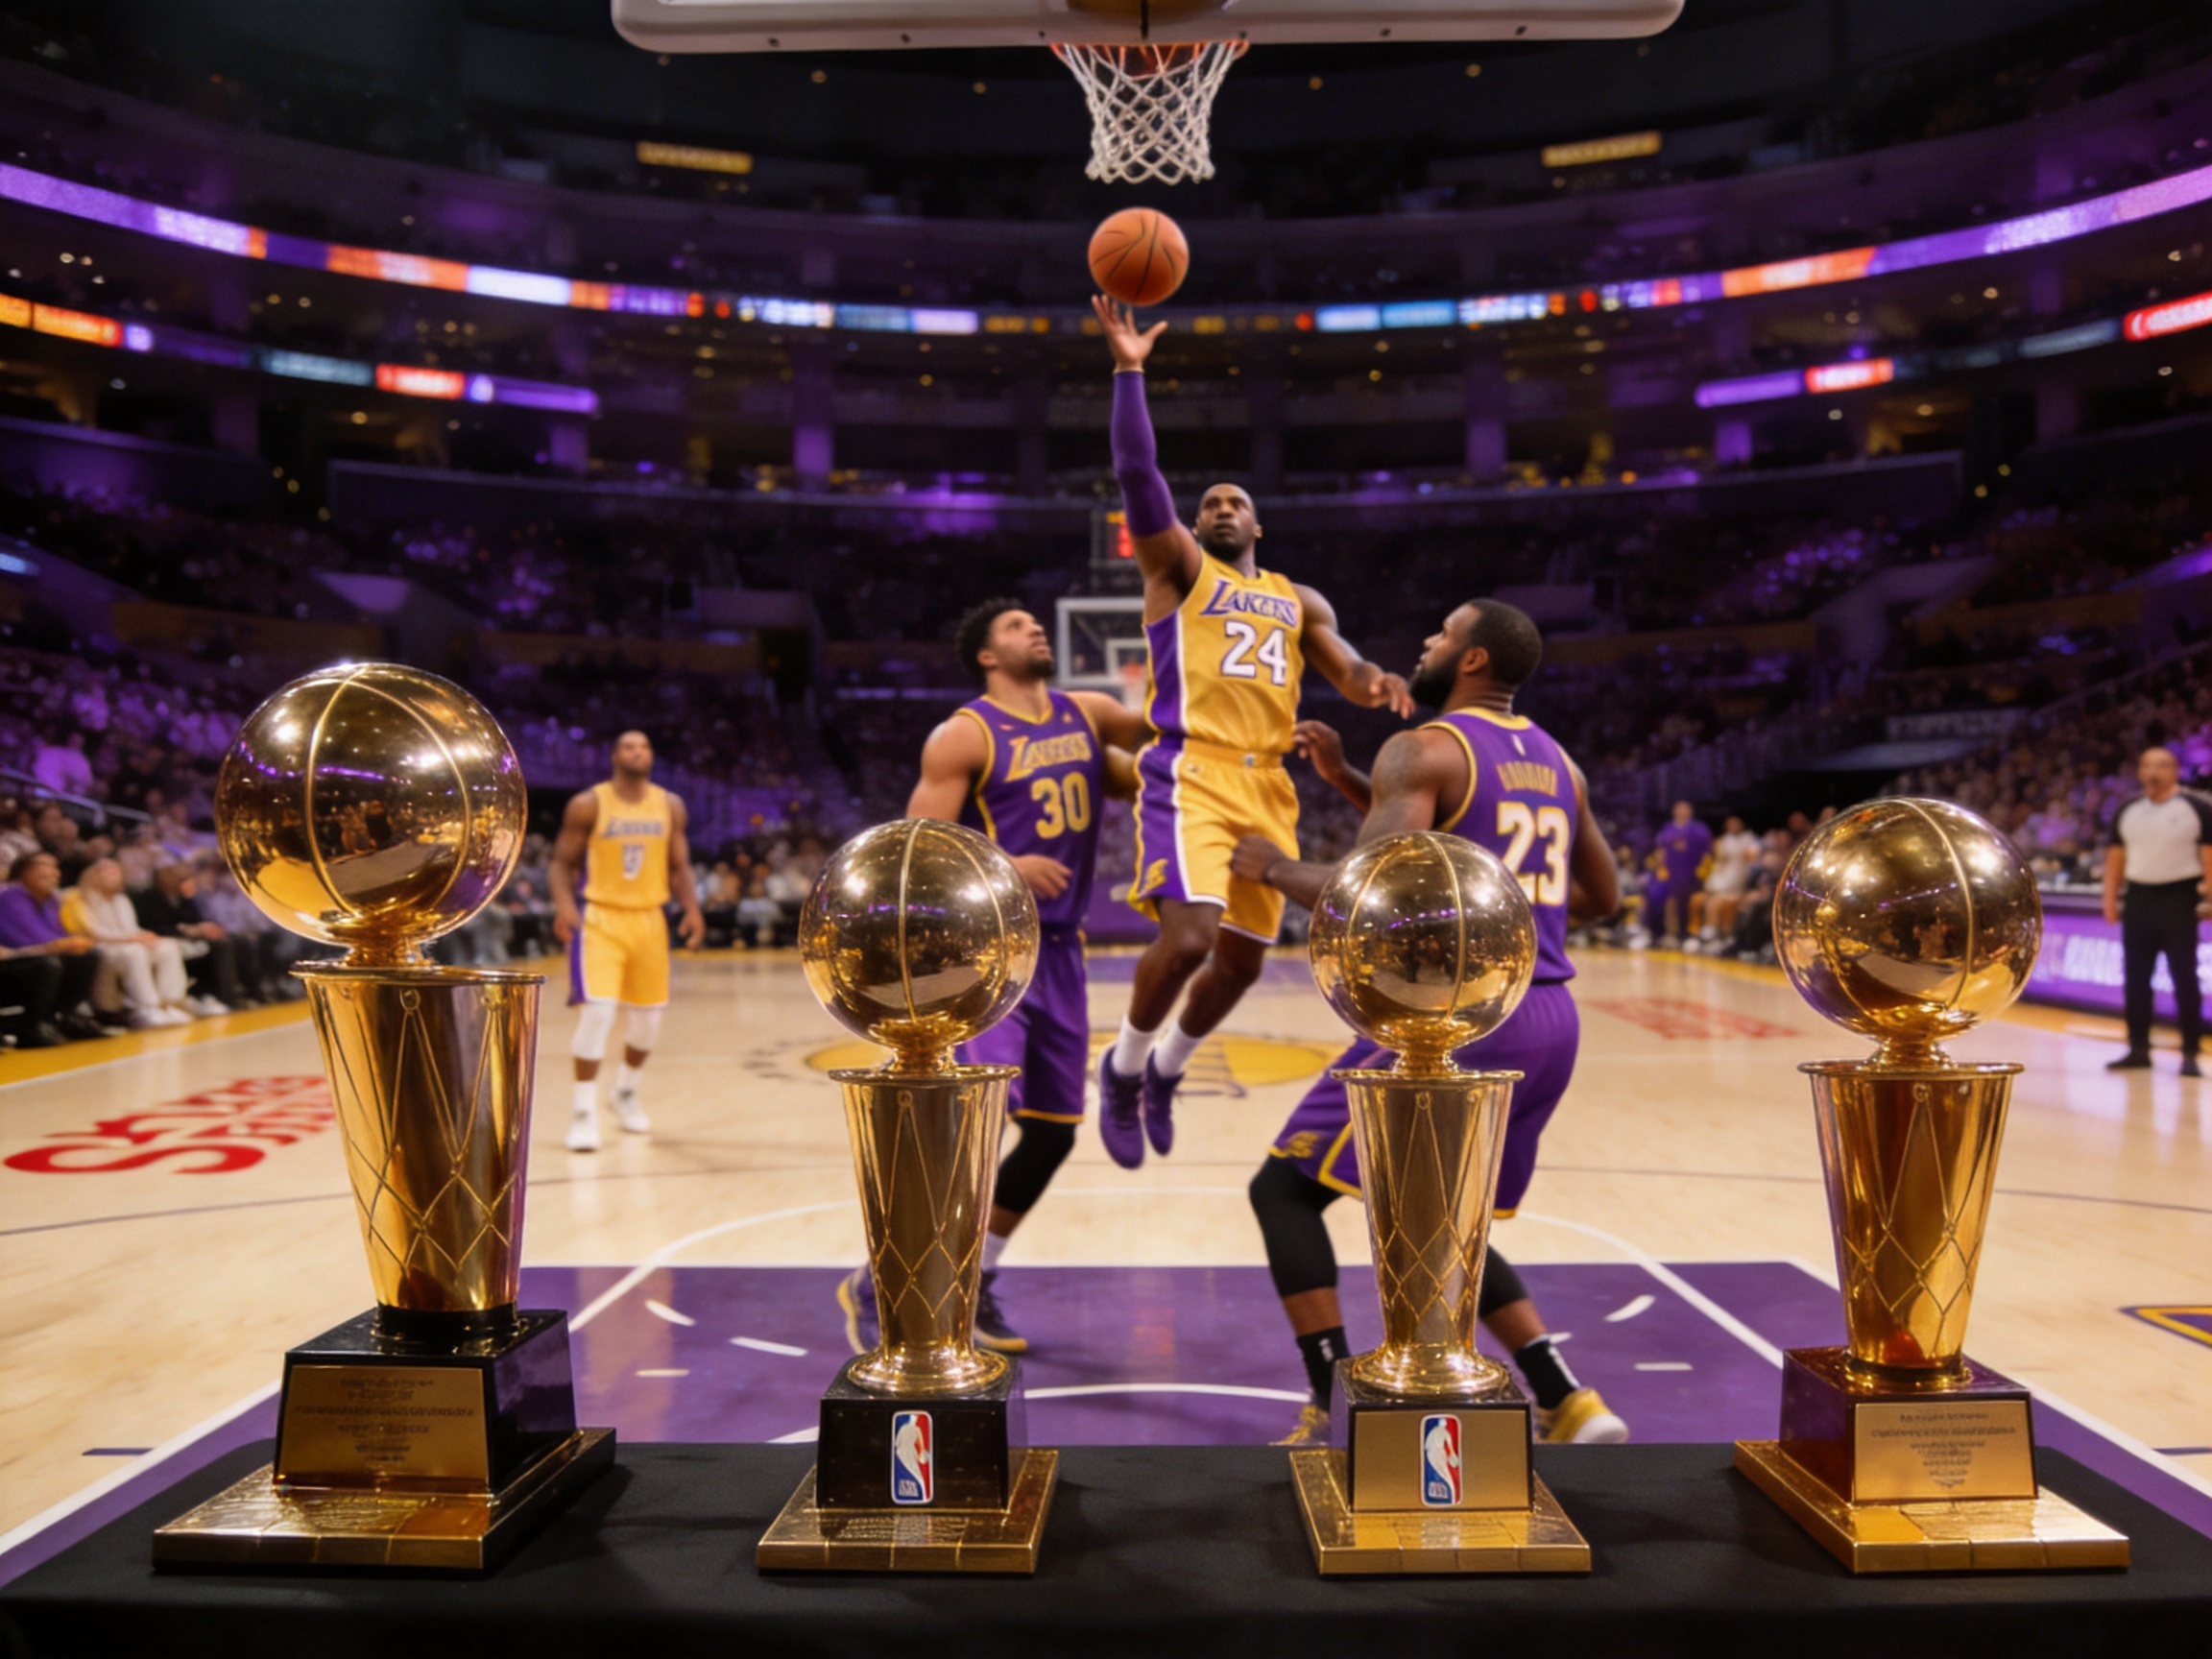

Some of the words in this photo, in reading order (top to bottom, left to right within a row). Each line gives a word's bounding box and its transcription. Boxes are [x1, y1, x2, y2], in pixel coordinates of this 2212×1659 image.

[1220, 619, 1287, 687] 24
[1030, 771, 1091, 839] 30
[1496, 800, 1570, 907] 23
